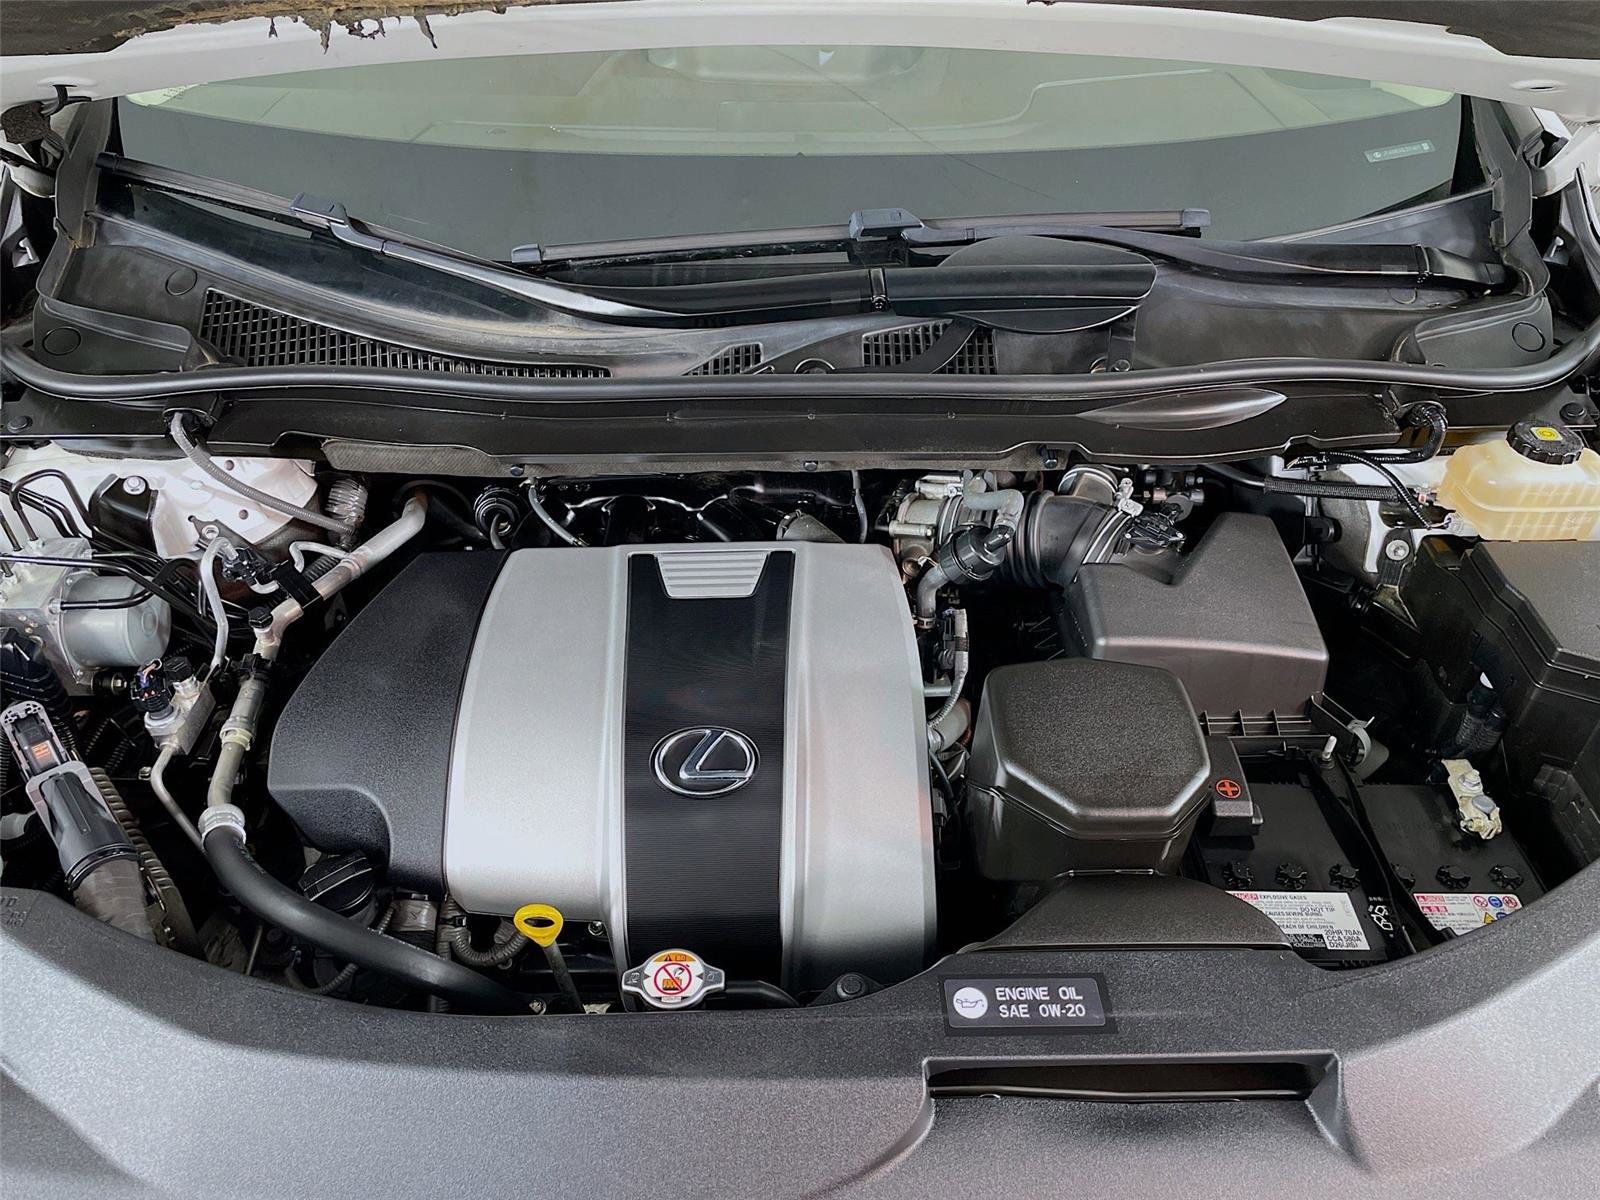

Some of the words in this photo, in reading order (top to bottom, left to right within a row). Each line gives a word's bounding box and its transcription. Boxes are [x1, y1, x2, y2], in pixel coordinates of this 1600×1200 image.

[995, 986, 1050, 1000] ENGINE
[1059, 986, 1083, 1000] OIL
[998, 1004, 1030, 1018] SAE
[1039, 1003, 1086, 1018] 0W-20
